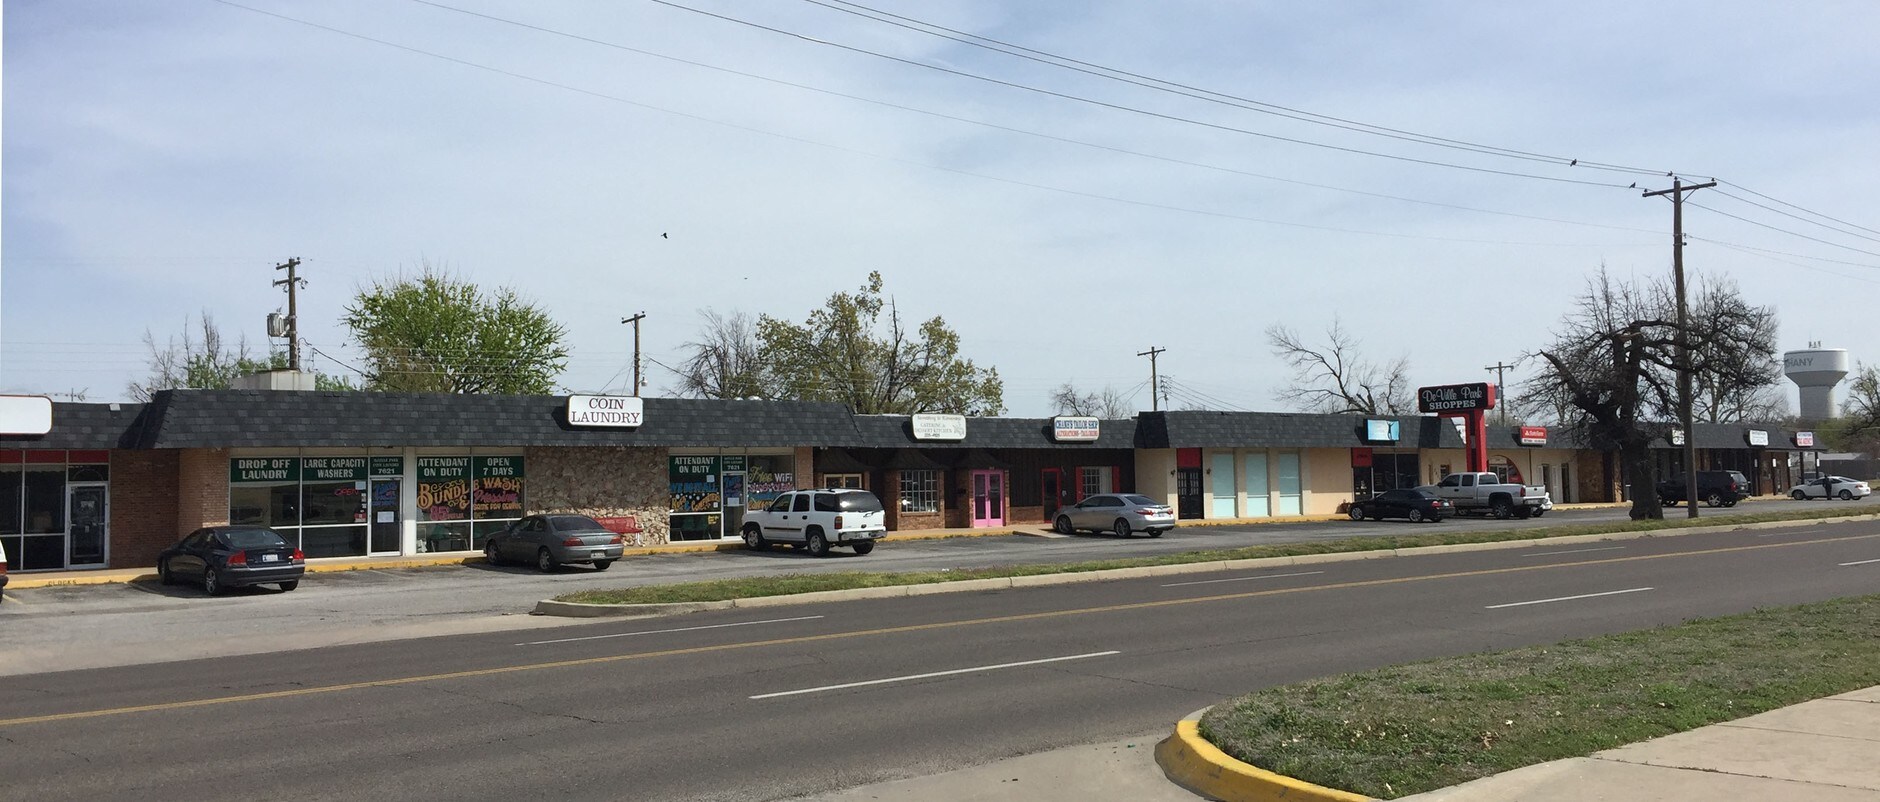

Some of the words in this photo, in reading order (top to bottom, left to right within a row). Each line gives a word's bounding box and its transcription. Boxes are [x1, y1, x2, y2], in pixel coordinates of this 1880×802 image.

[1461, 386, 1483, 400] Park
[588, 397, 625, 410] COIN
[1429, 399, 1476, 410] SHOPPES
[571, 410, 641, 424] LAUNDRY
[238, 459, 268, 469] DROP
[271, 459, 291, 469] OFF
[304, 458, 328, 469] LARGE
[331, 458, 366, 468] CAPACITY
[418, 458, 468, 467] ATTENDANT
[487, 457, 510, 466] OPEN
[674, 456, 715, 465] ATTENDANT
[317, 469, 354, 478] WASHERS
[423, 467, 436, 477] ON
[440, 467, 463, 476] DUTY
[492, 467, 514, 475] DAYS
[679, 465, 689, 473] ON
[692, 465, 710, 473] DUTY
[748, 465, 773, 483] Free
[774, 472, 793, 482] WiFi
[242, 469, 289, 480] LAUNDRY
[483, 477, 522, 493] WASH
